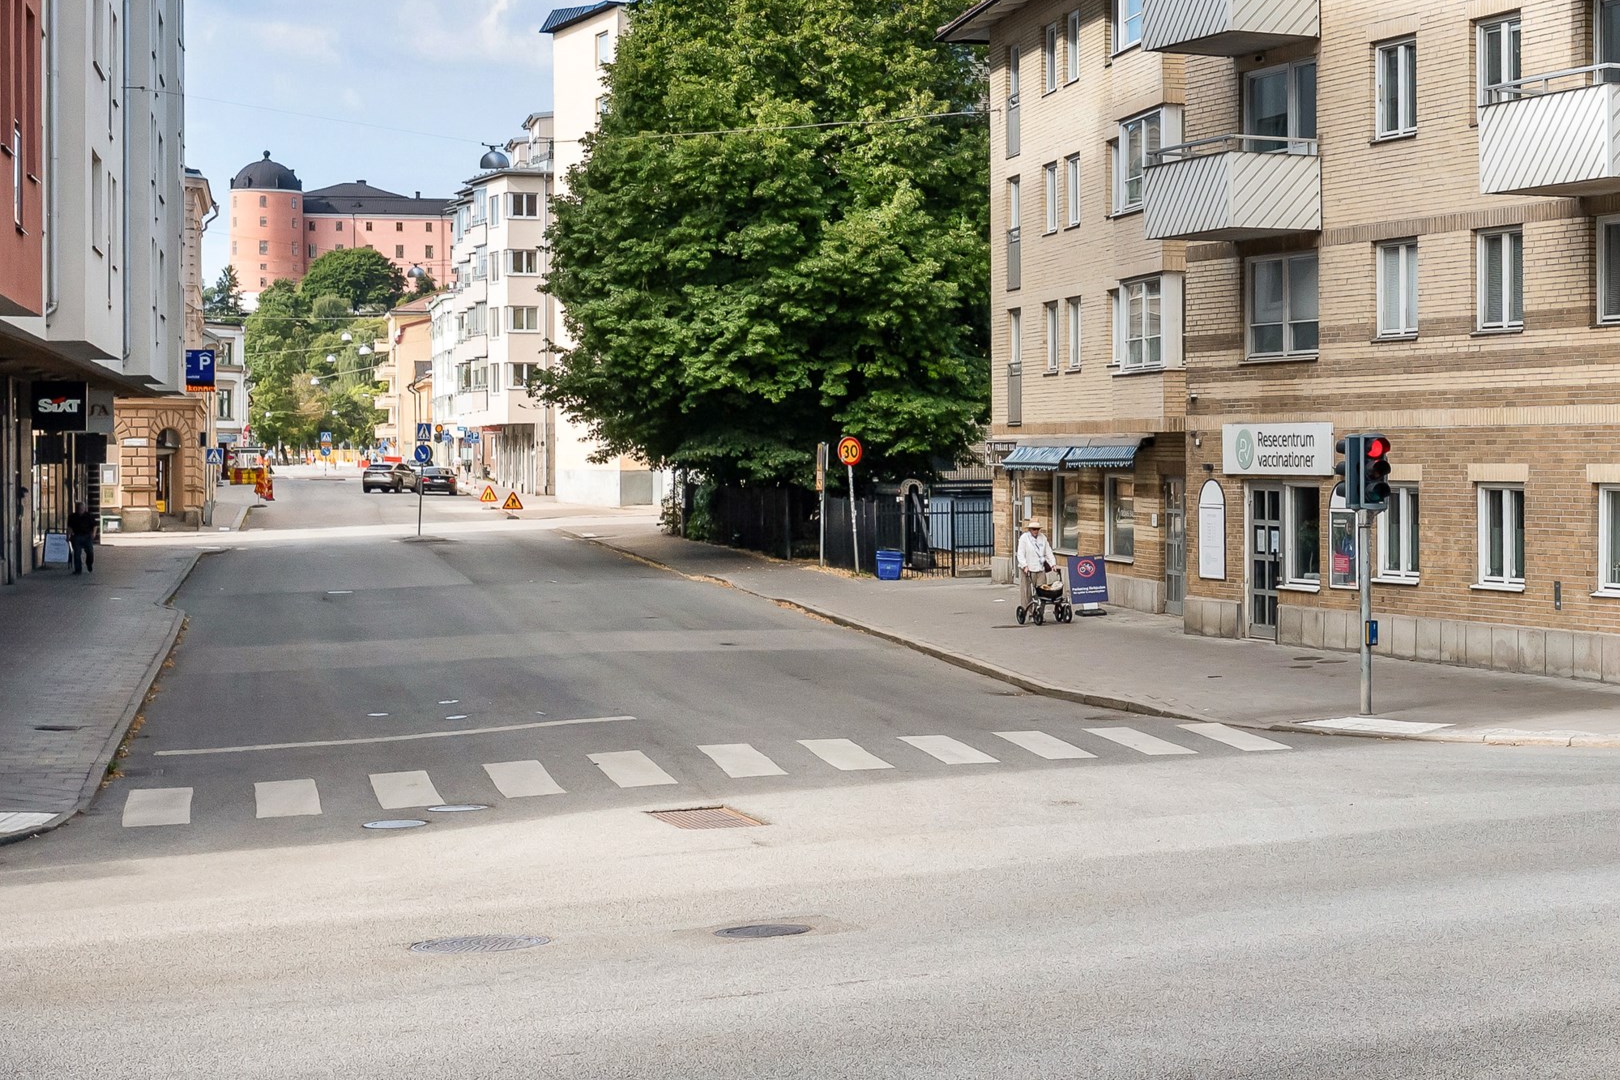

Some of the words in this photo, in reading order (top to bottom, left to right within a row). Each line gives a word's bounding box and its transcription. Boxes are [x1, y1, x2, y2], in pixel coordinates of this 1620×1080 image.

[1257, 431, 1315, 448] Resecentrum
[842, 444, 858, 459] 30
[1257, 451, 1315, 468] vaccinationer
